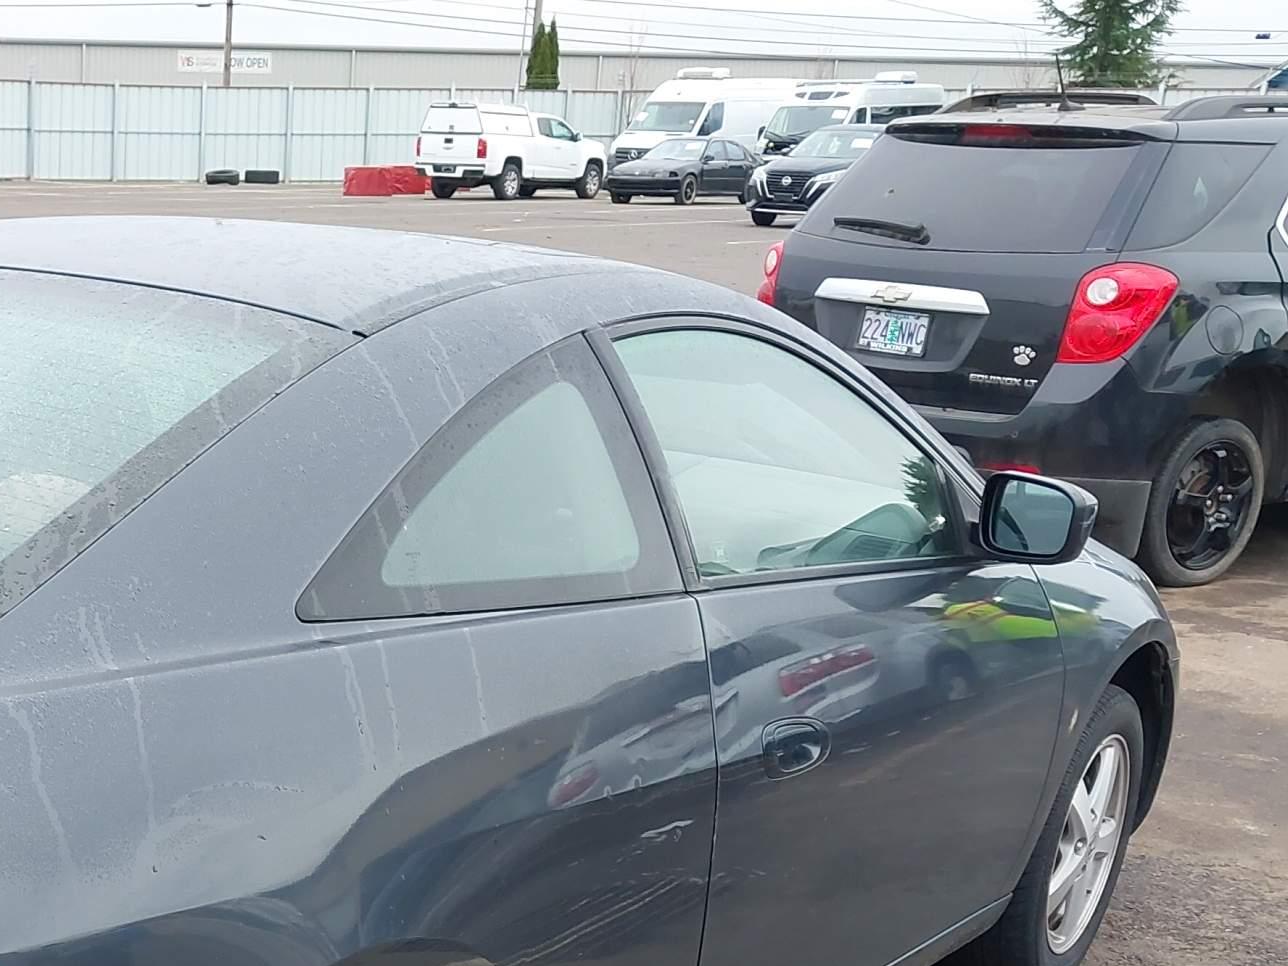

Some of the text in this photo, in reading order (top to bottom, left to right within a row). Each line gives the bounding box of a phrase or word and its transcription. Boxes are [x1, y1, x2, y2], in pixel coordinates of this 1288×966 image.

[245, 57, 269, 69] OPEN
[861, 317, 927, 346] 224 NWC
[969, 373, 1039, 388] EQUINOX LT
